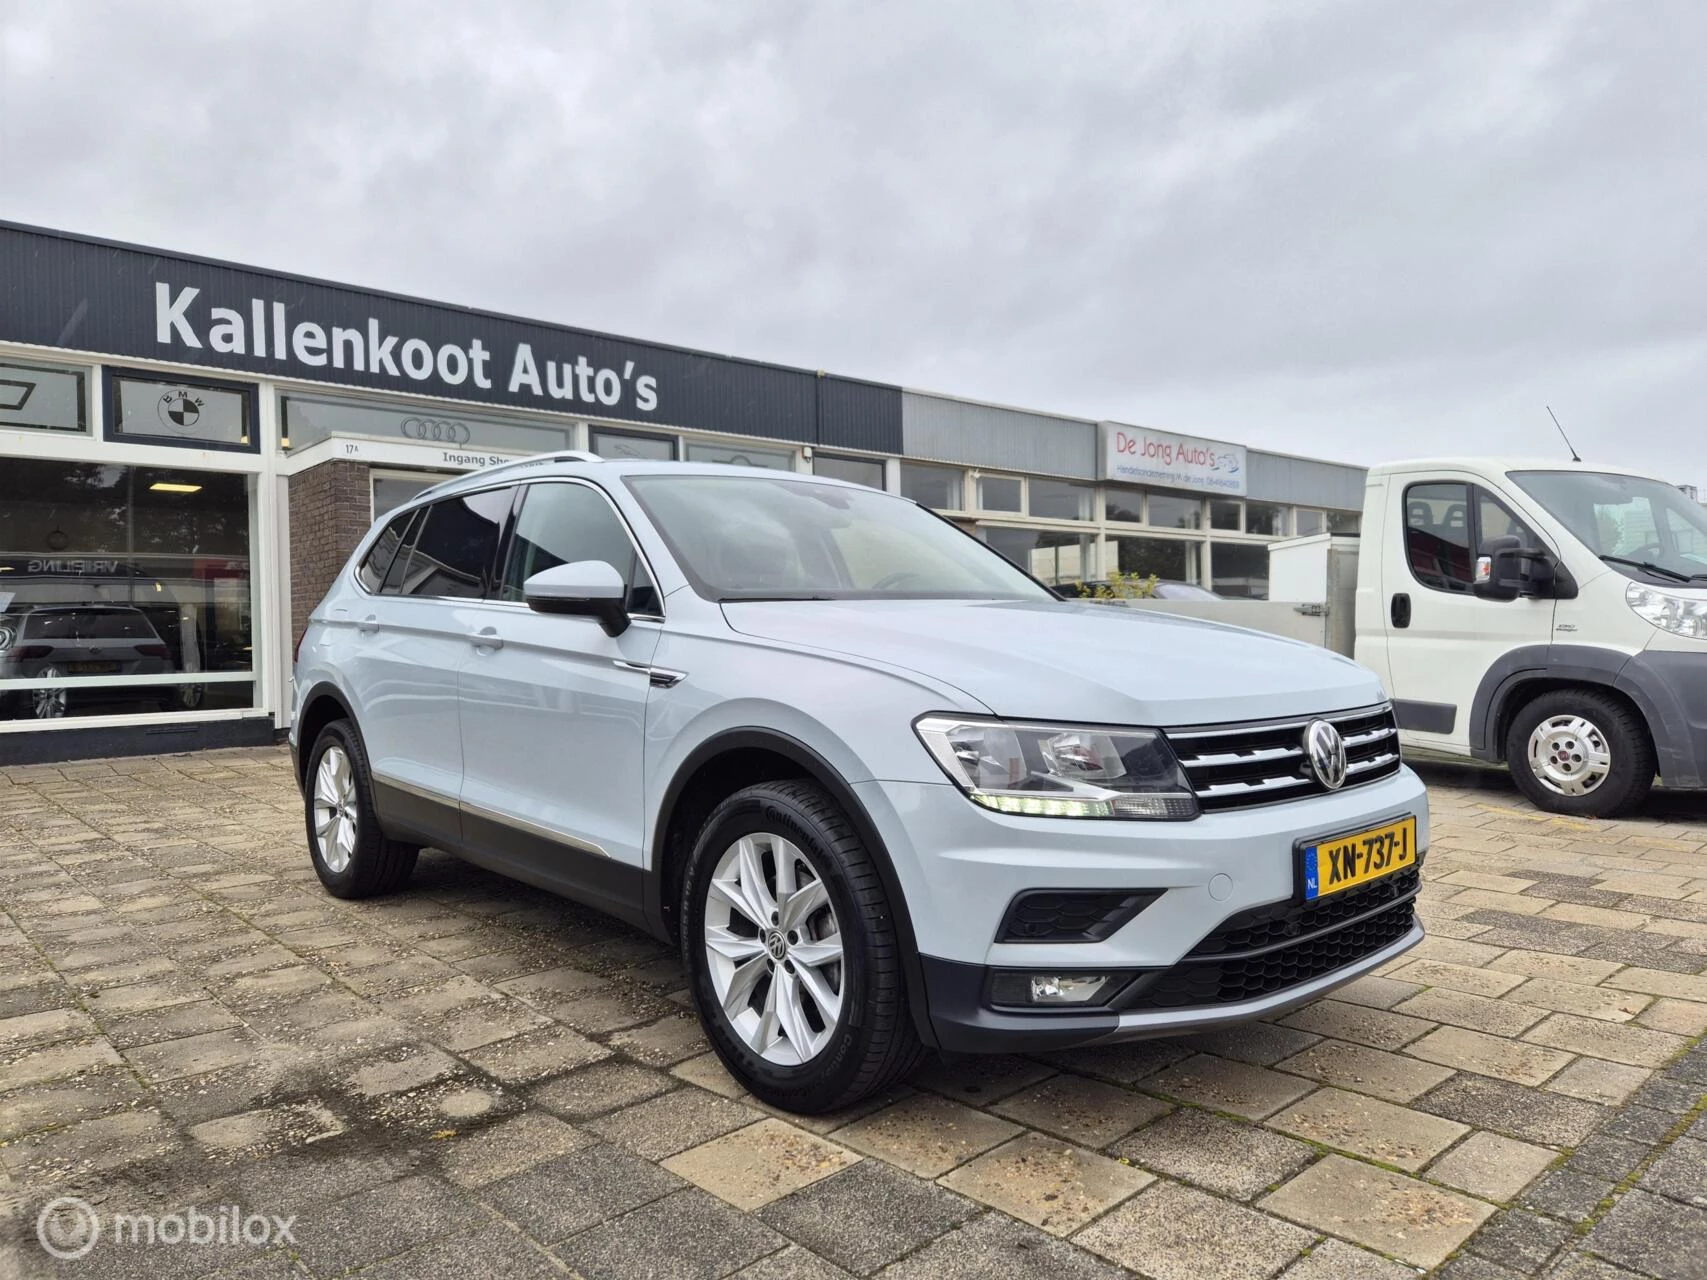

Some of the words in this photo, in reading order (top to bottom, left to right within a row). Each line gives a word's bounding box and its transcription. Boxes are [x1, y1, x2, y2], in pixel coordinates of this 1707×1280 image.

[156, 282, 491, 389] Kallenkoot
[508, 343, 658, 411] Auto's
[163, 391, 205, 407] BMW
[443, 452, 485, 467] Ingang
[1116, 432, 1136, 455] De
[1141, 437, 1172, 465] Jong
[1176, 444, 1216, 467] Auto's
[1328, 827, 1407, 885] XN-737-J
[1307, 877, 1318, 890] NL
